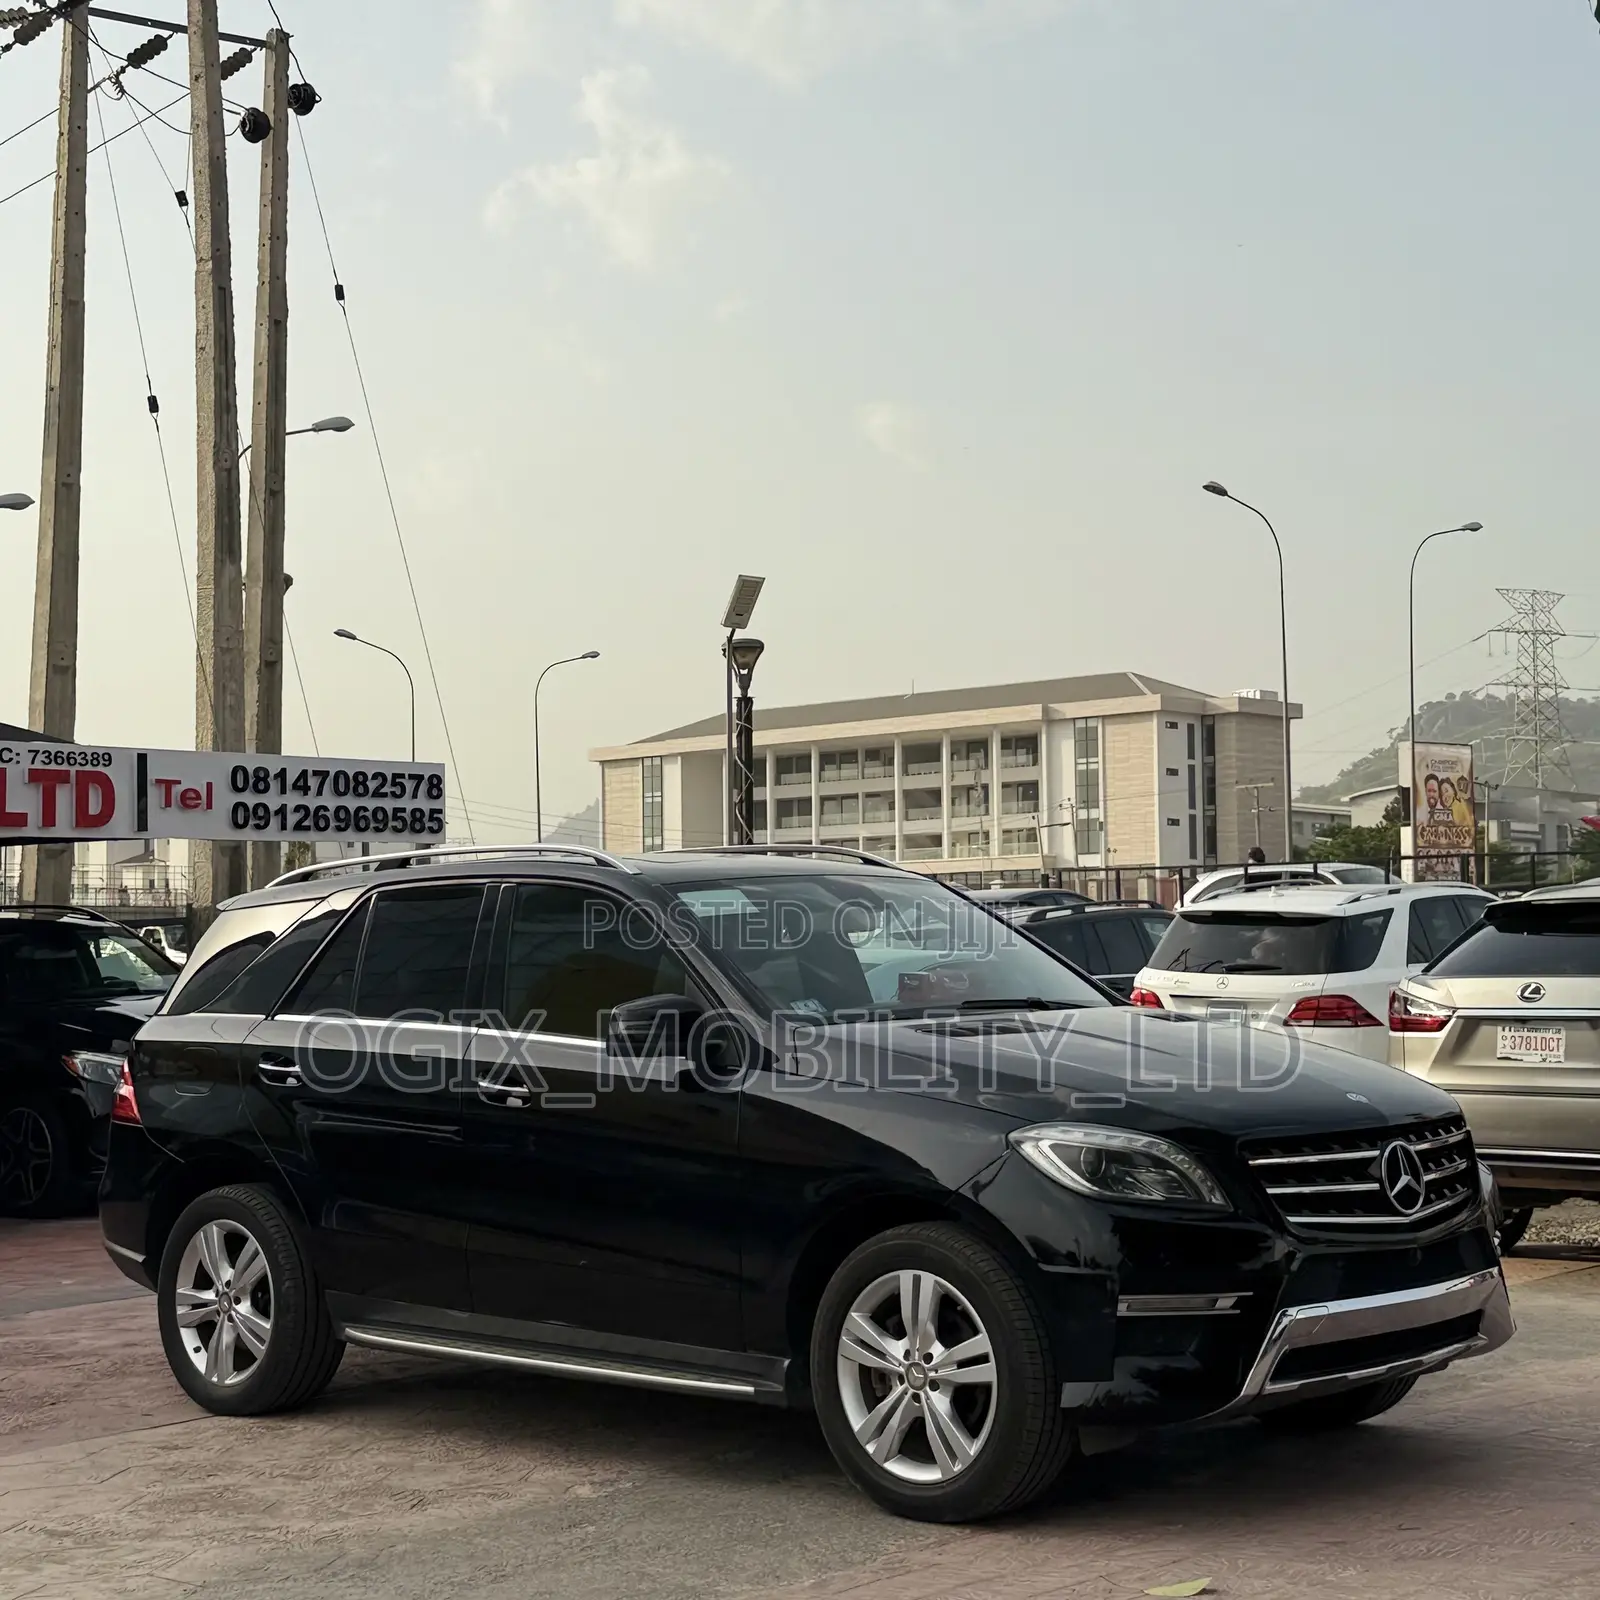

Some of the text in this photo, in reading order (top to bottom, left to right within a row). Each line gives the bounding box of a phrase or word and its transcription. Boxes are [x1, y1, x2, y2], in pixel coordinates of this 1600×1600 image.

[27, 749, 113, 768] 7366389
[0, 768, 116, 829] LTD
[154, 778, 213, 811] Tel
[230, 765, 444, 801] 08147082578
[230, 801, 445, 835] 09126969585
